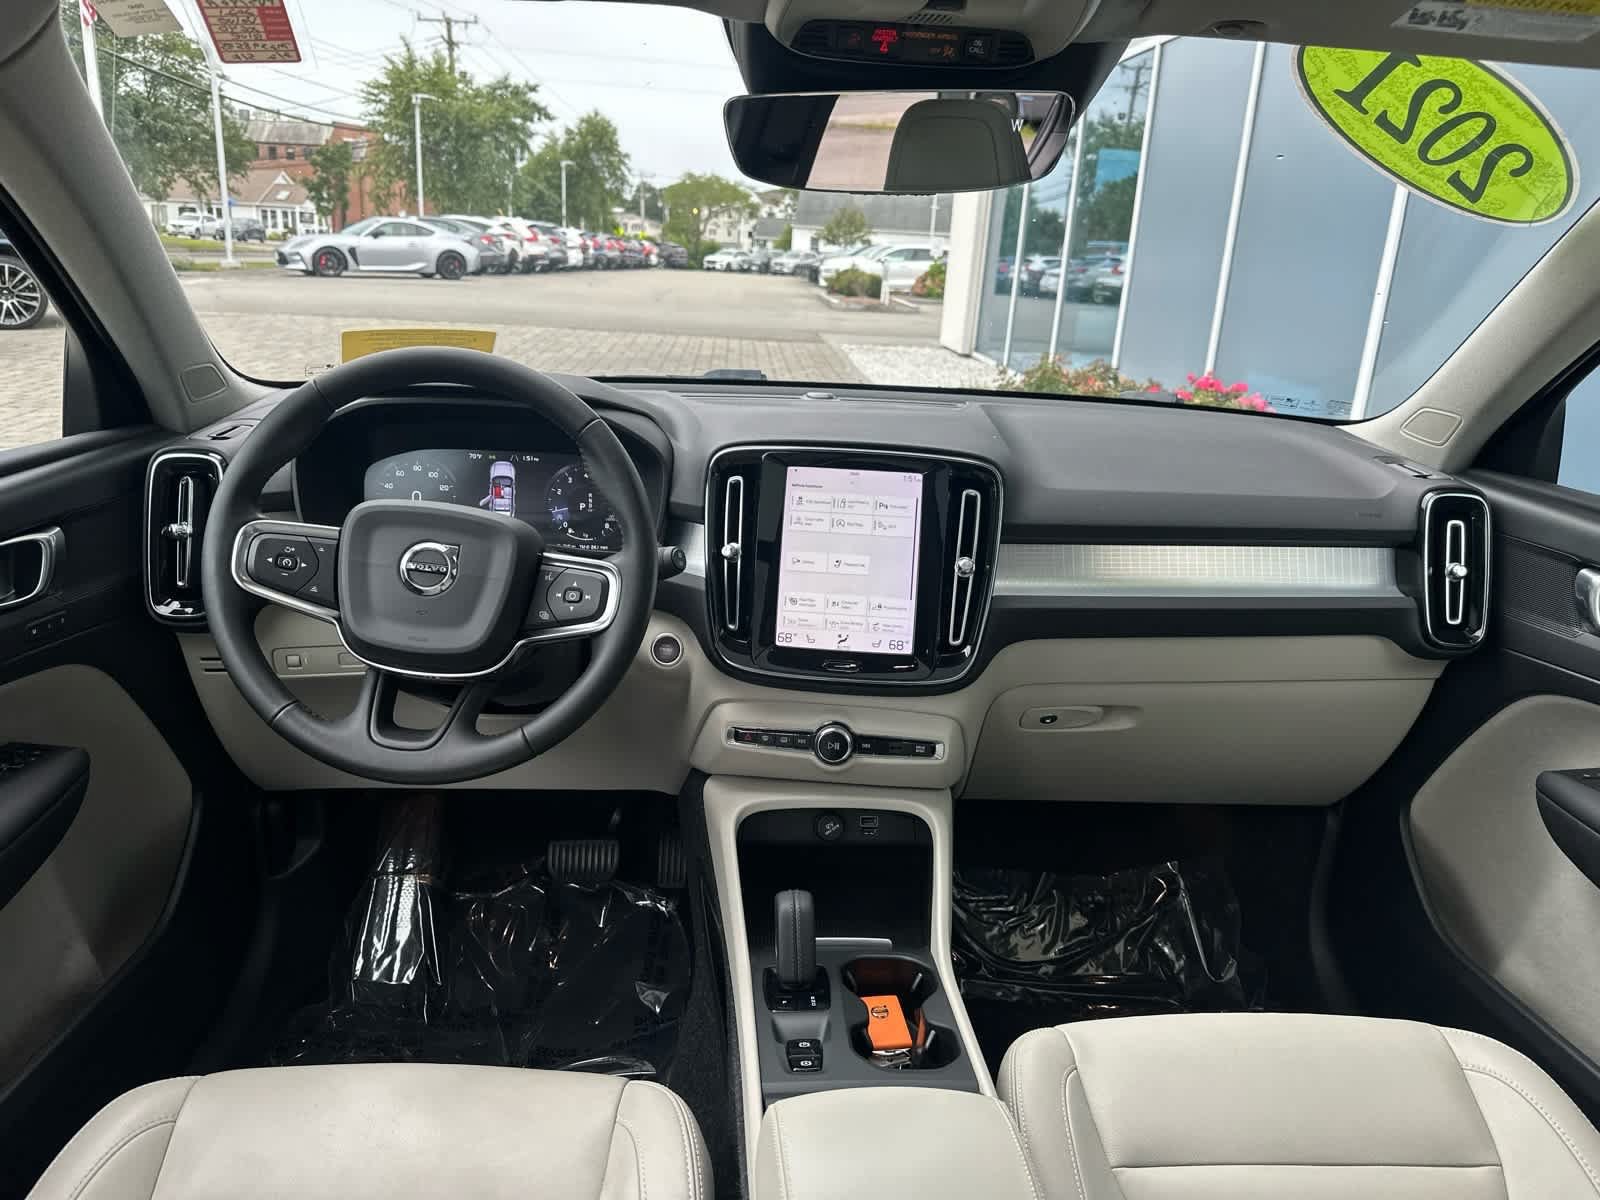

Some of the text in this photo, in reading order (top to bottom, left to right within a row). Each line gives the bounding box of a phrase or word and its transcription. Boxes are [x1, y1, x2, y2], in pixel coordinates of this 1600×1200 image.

[1010, 118, 1024, 132] W
[579, 502, 586, 511] P
[406, 562, 447, 573] VOLVO
